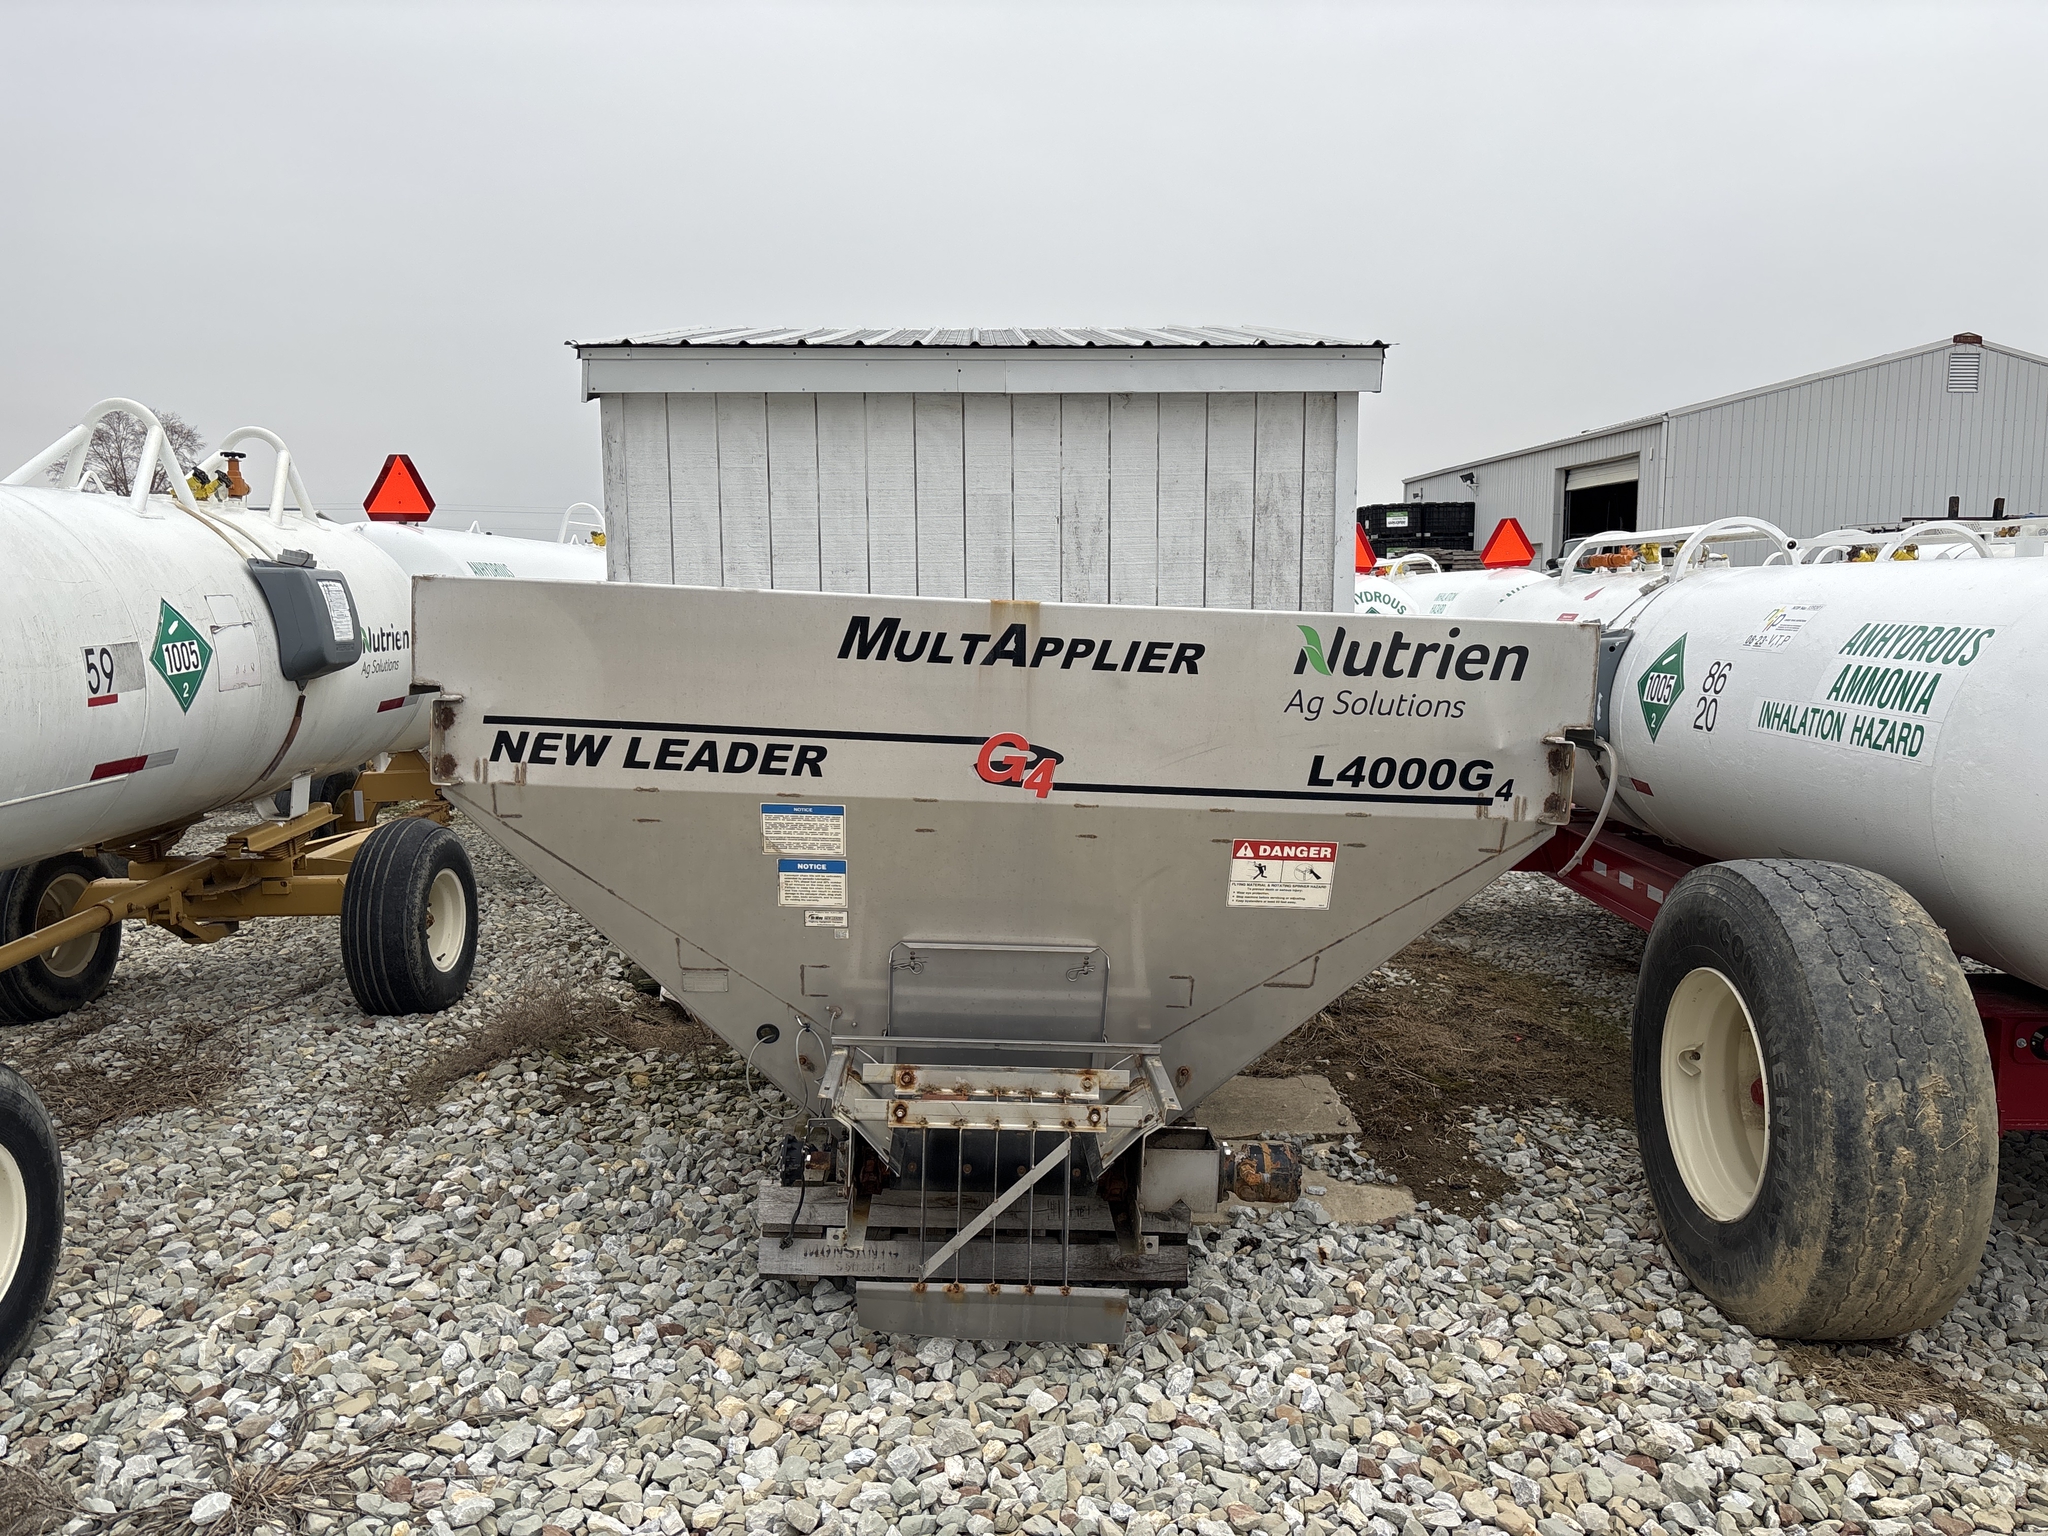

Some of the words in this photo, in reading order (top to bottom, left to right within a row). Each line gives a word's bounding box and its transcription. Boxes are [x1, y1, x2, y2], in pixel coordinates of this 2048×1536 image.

[360, 623, 410, 654] Nutrien
[1293, 624, 1529, 681] Nutrien
[1838, 622, 1995, 667] ANHYDROUS
[84, 647, 114, 695] 59
[164, 641, 200, 673] 1005
[361, 661, 371, 678] Ag
[372, 659, 400, 674] Solutions
[182, 683, 189, 698] 2
[1645, 674, 1675, 704] 1005
[1702, 660, 1733, 694] 86
[1826, 663, 1942, 715] AMMONIA
[1283, 689, 1325, 721] Ag
[1332, 690, 1466, 718] Solutions
[1651, 712, 1657, 728] 2
[1693, 696, 1718, 732] 20
[1757, 700, 1847, 742] INHALATION
[1850, 714, 1925, 758] HAZARD
[489, 730, 611, 768] NEW
[622, 736, 828, 778] LEADER
[977, 731, 1057, 799] G4
[1258, 845, 1332, 858] DANGER
